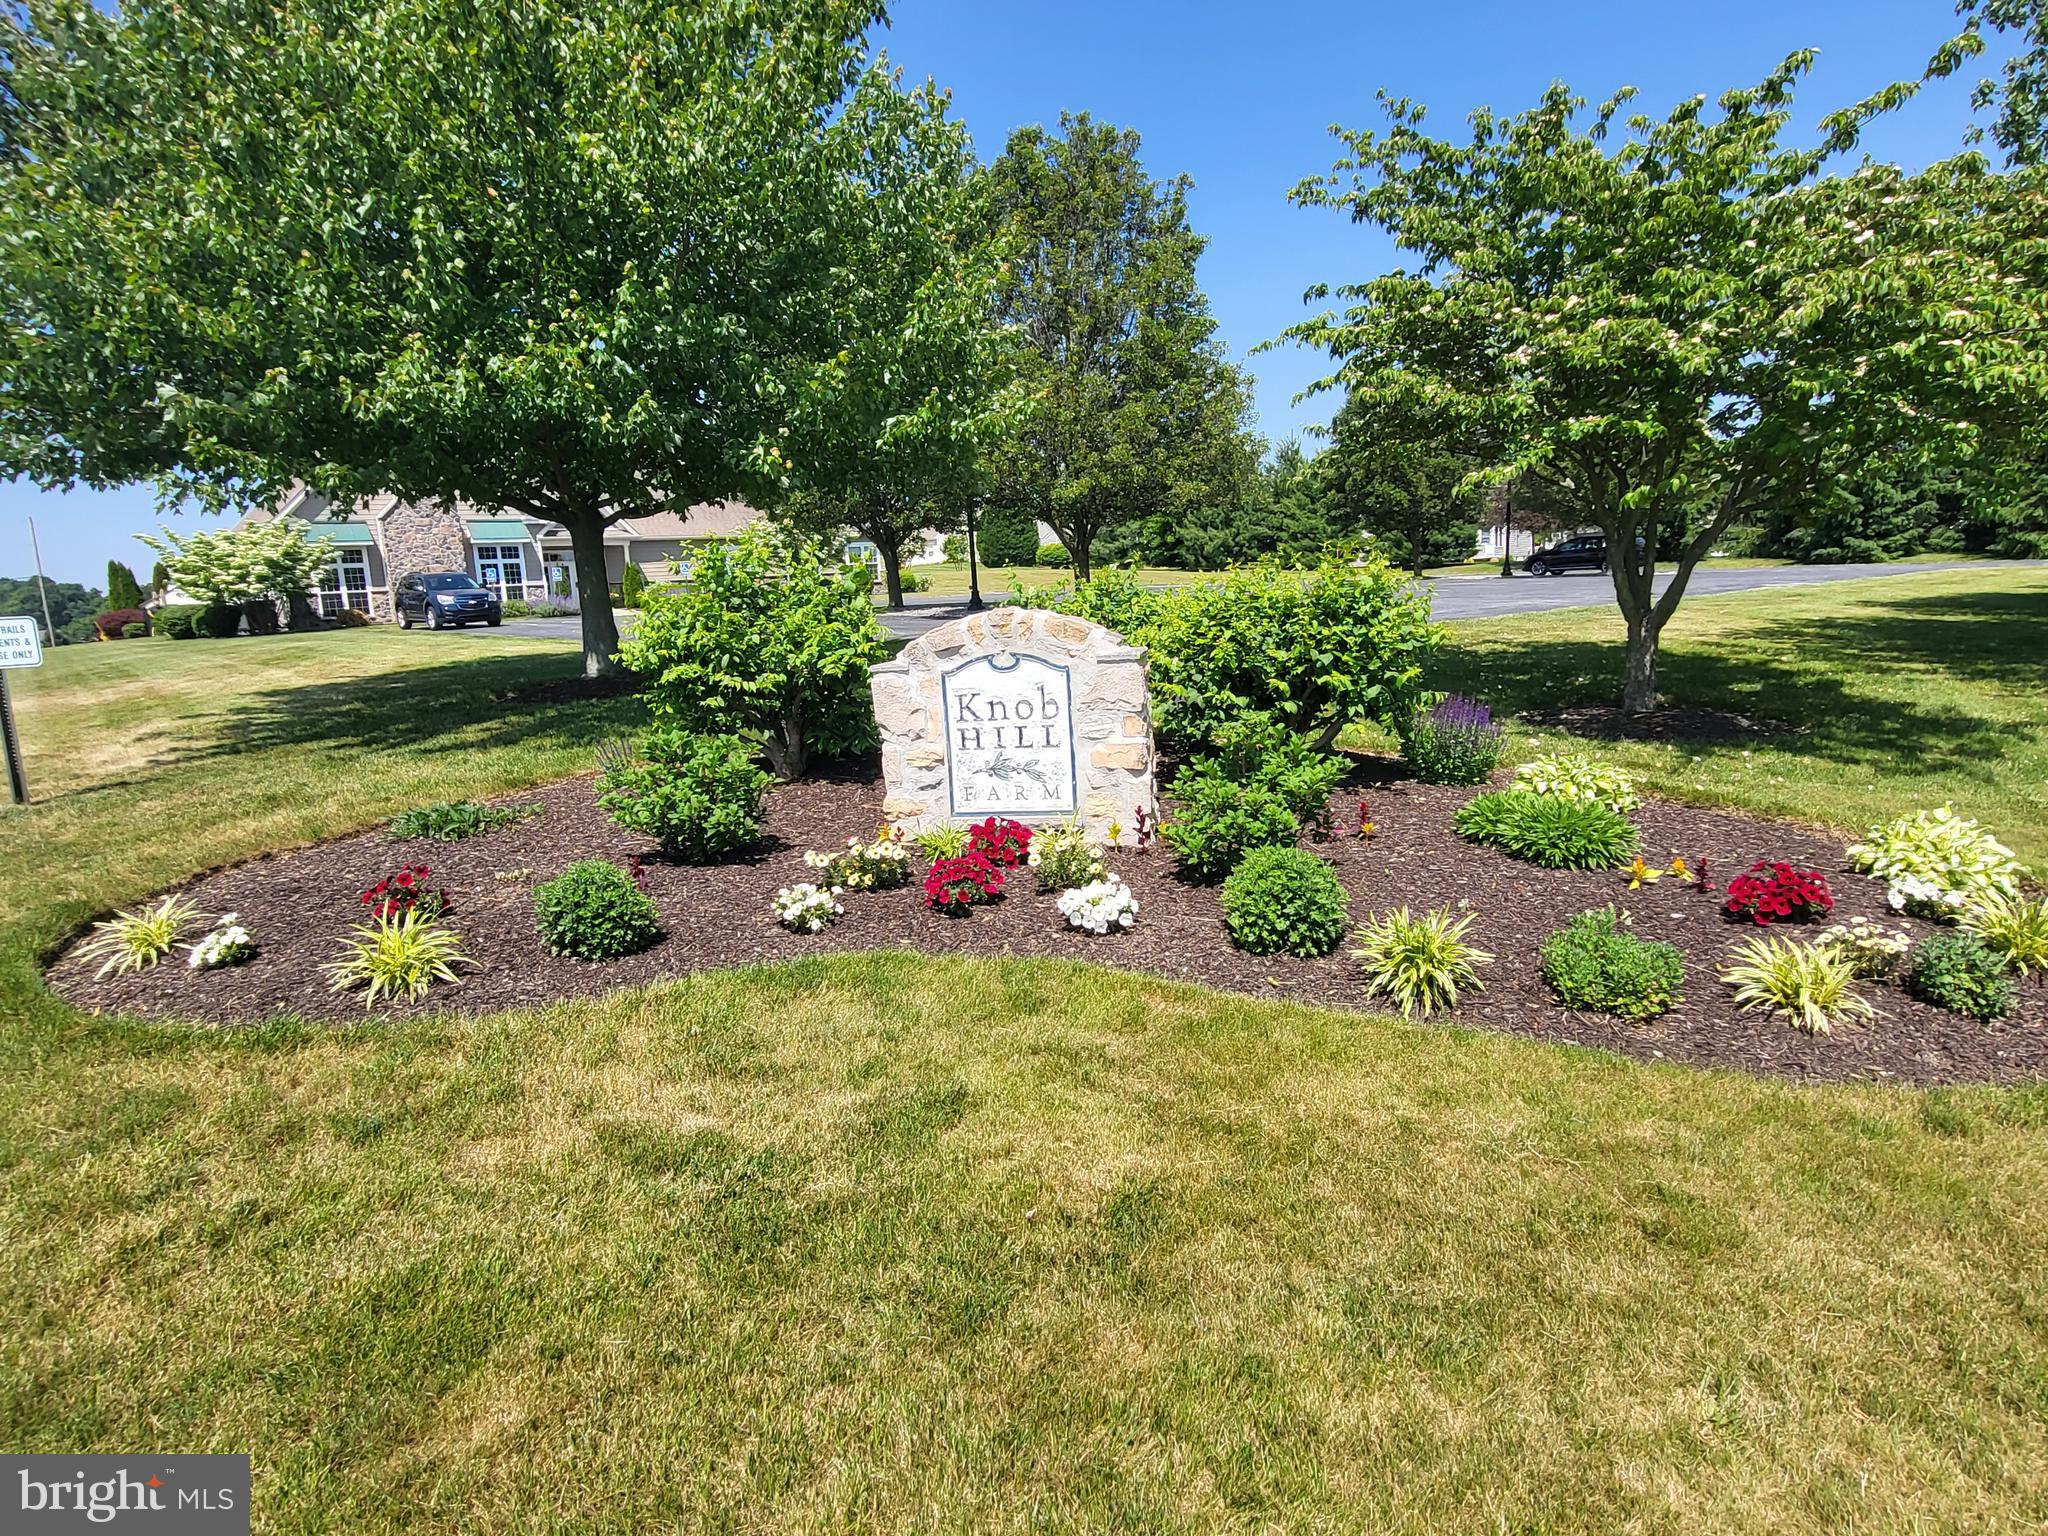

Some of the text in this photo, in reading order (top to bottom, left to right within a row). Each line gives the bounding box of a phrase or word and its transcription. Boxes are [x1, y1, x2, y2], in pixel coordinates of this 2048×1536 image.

[0, 625, 26, 634] RAILS
[12, 650, 33, 659] ONLY
[954, 684, 1060, 723] Knob
[957, 724, 1061, 751] HILL
[963, 784, 1062, 801] FARM
